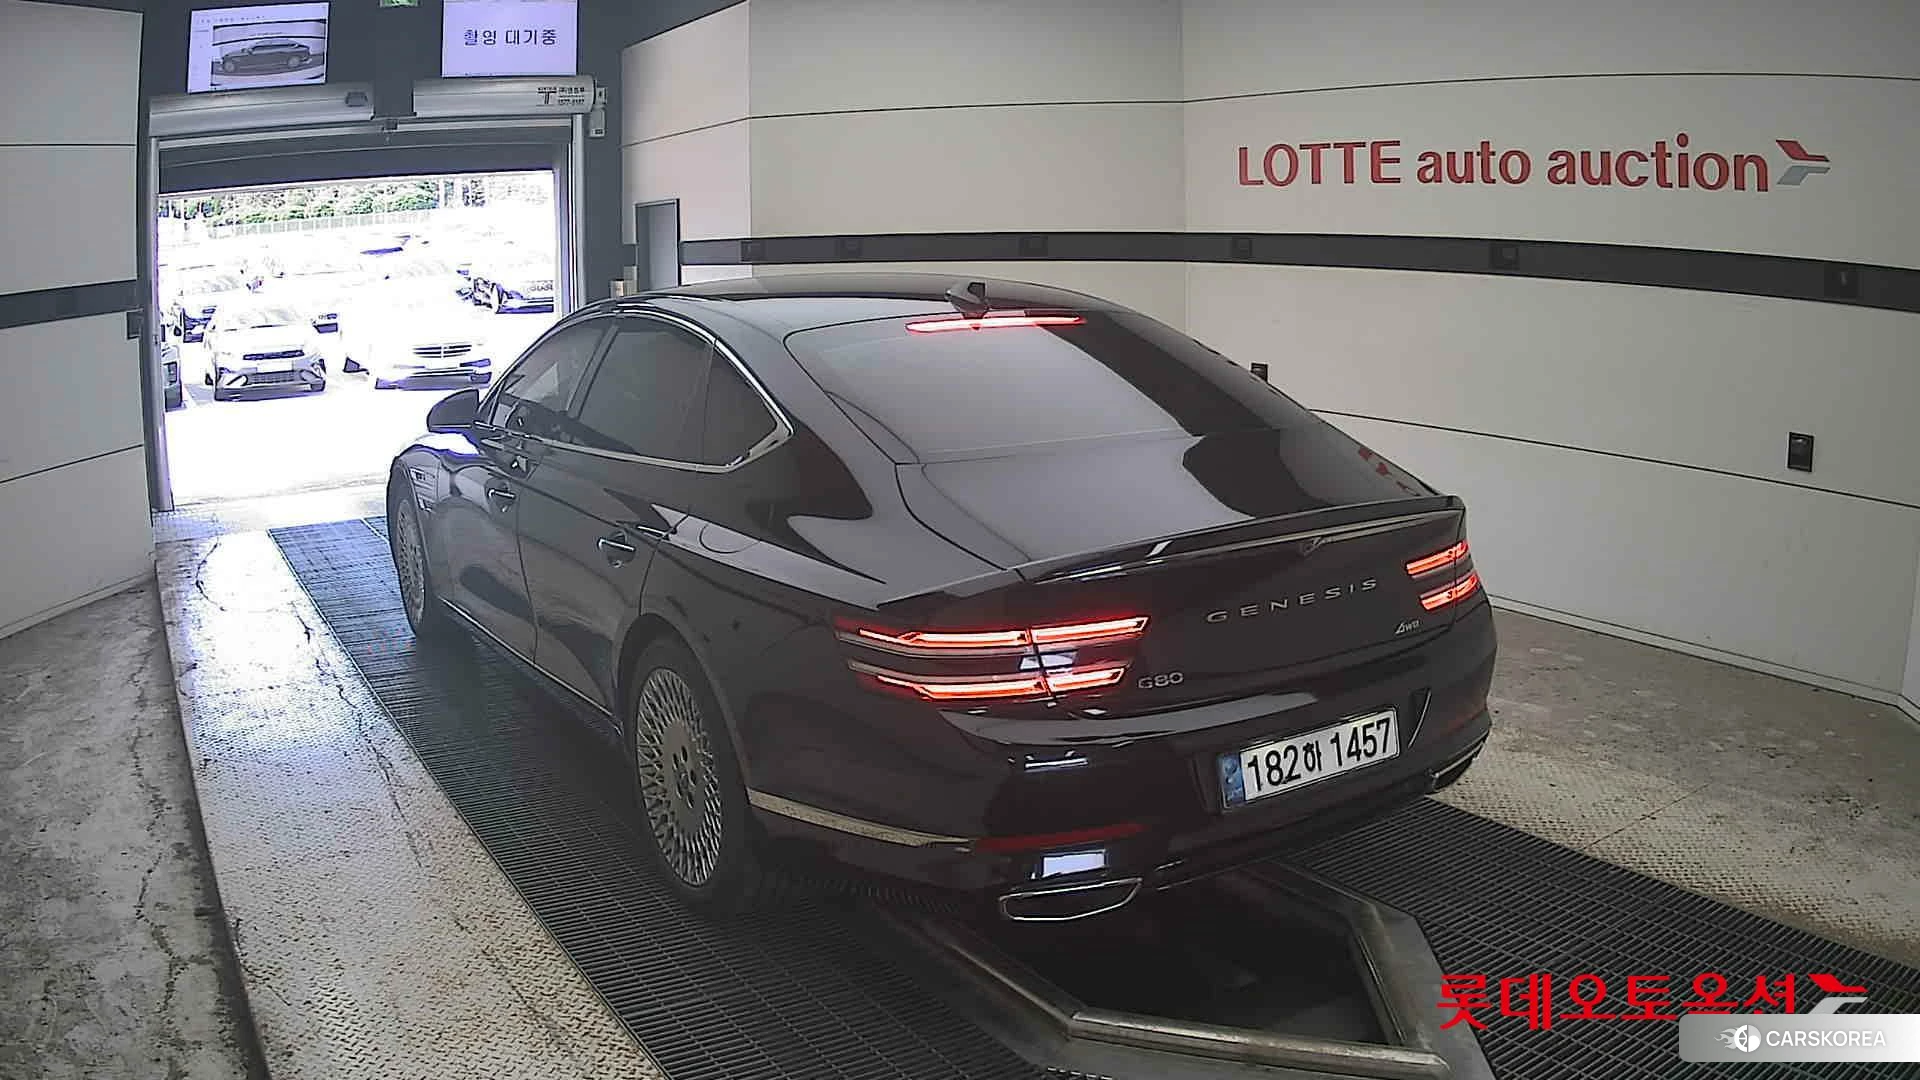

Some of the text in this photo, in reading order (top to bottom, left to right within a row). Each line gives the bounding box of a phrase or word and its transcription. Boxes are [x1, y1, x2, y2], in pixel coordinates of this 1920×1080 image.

[505, 29, 557, 46] 대기중
[1239, 132, 1769, 192] LOTTE auto auction
[1206, 577, 1378, 624] GENESIS
[1137, 671, 1185, 690] G80
[1247, 740, 1323, 793] 182하
[1330, 717, 1391, 768] 1457
